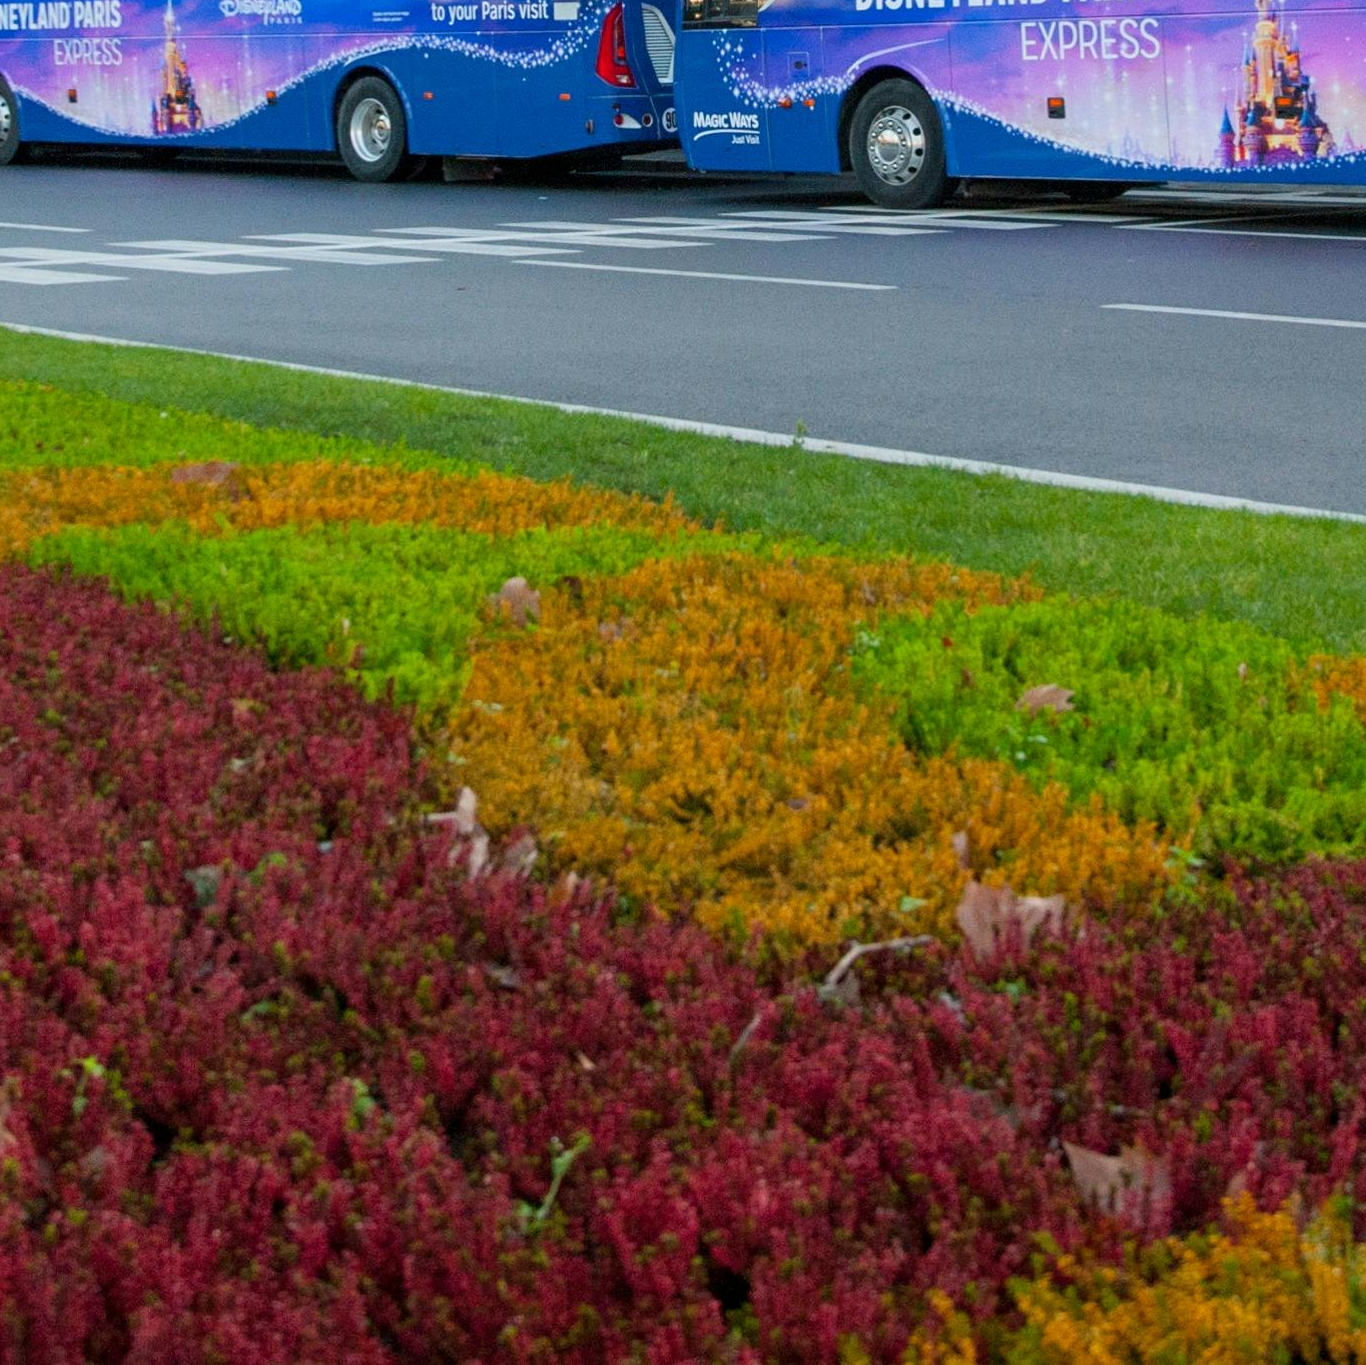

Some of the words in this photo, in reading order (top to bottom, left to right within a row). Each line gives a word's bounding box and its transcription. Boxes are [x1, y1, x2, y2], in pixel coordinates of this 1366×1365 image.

[74, 0, 122, 28] PARIS
[269, 16, 303, 24] PARIS
[431, 2, 445, 21] to
[448, 4, 479, 25] your
[482, 0, 515, 21] Paris
[519, 0, 549, 19] visit
[53, 38, 123, 66] EXPRESS
[1020, 18, 1161, 61] EXPRESS
[693, 111, 728, 128] MAGIC
